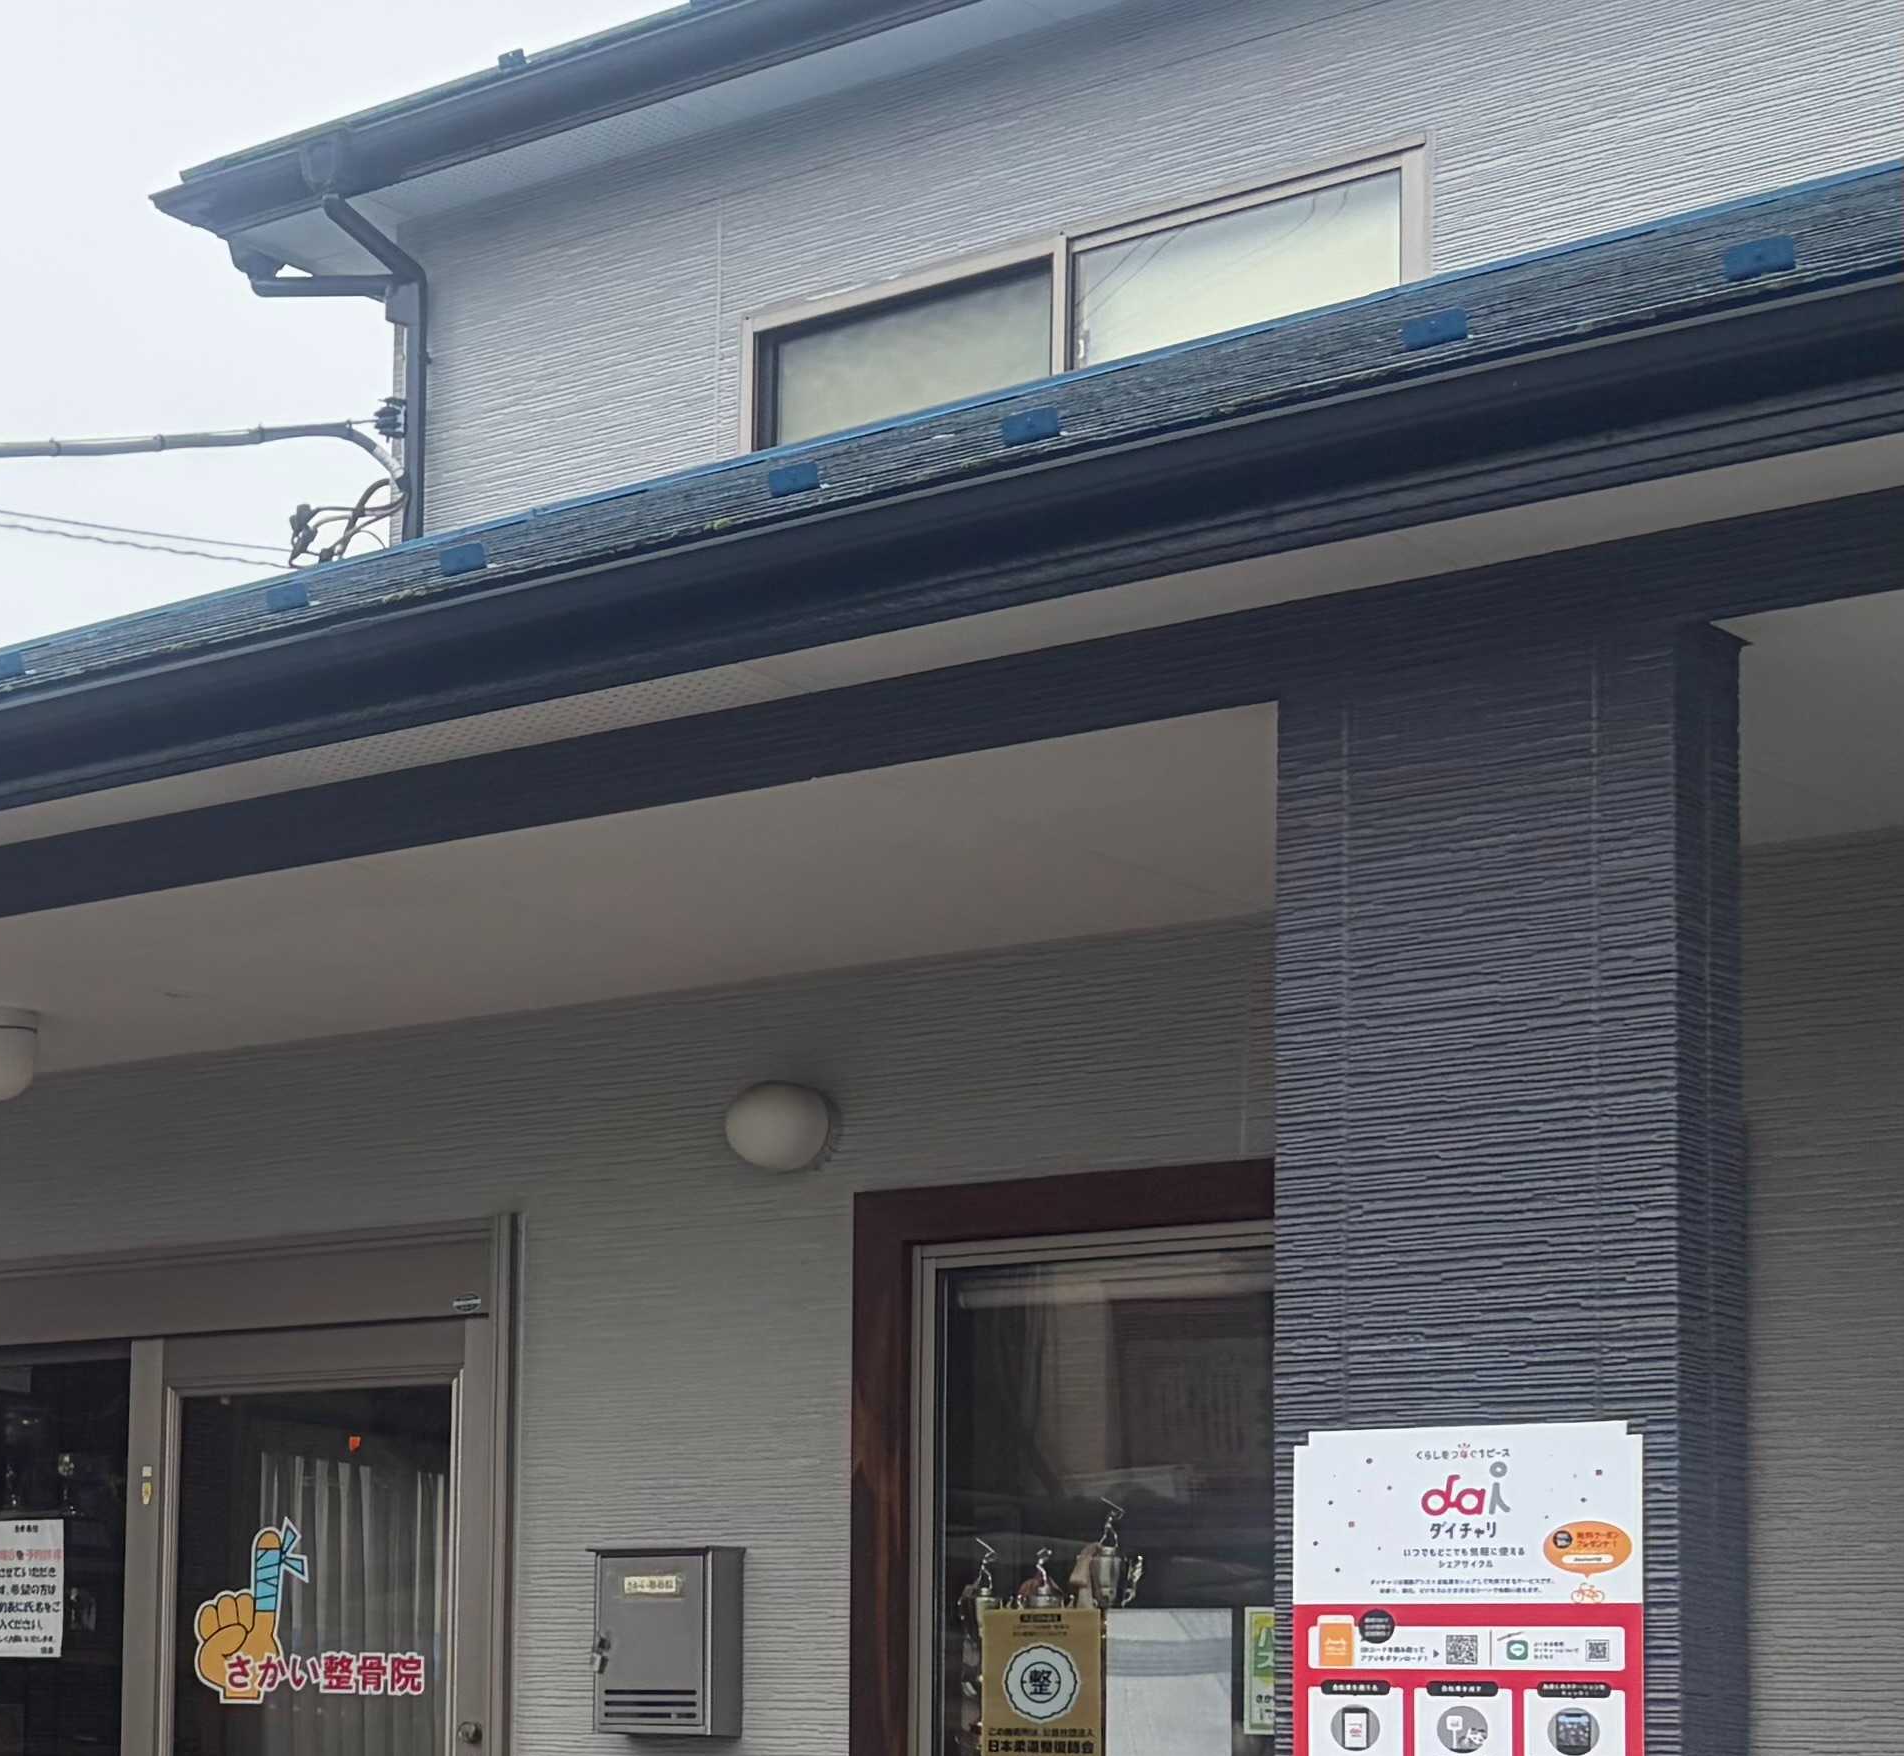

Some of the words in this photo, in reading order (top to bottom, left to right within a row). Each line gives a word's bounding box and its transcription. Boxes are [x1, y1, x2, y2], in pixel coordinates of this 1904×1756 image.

[1429, 1521, 1497, 1540] ダイチャリ
[1438, 1560, 1494, 1568] シェアサイクル
[227, 1654, 423, 1693] さかい整骨院
